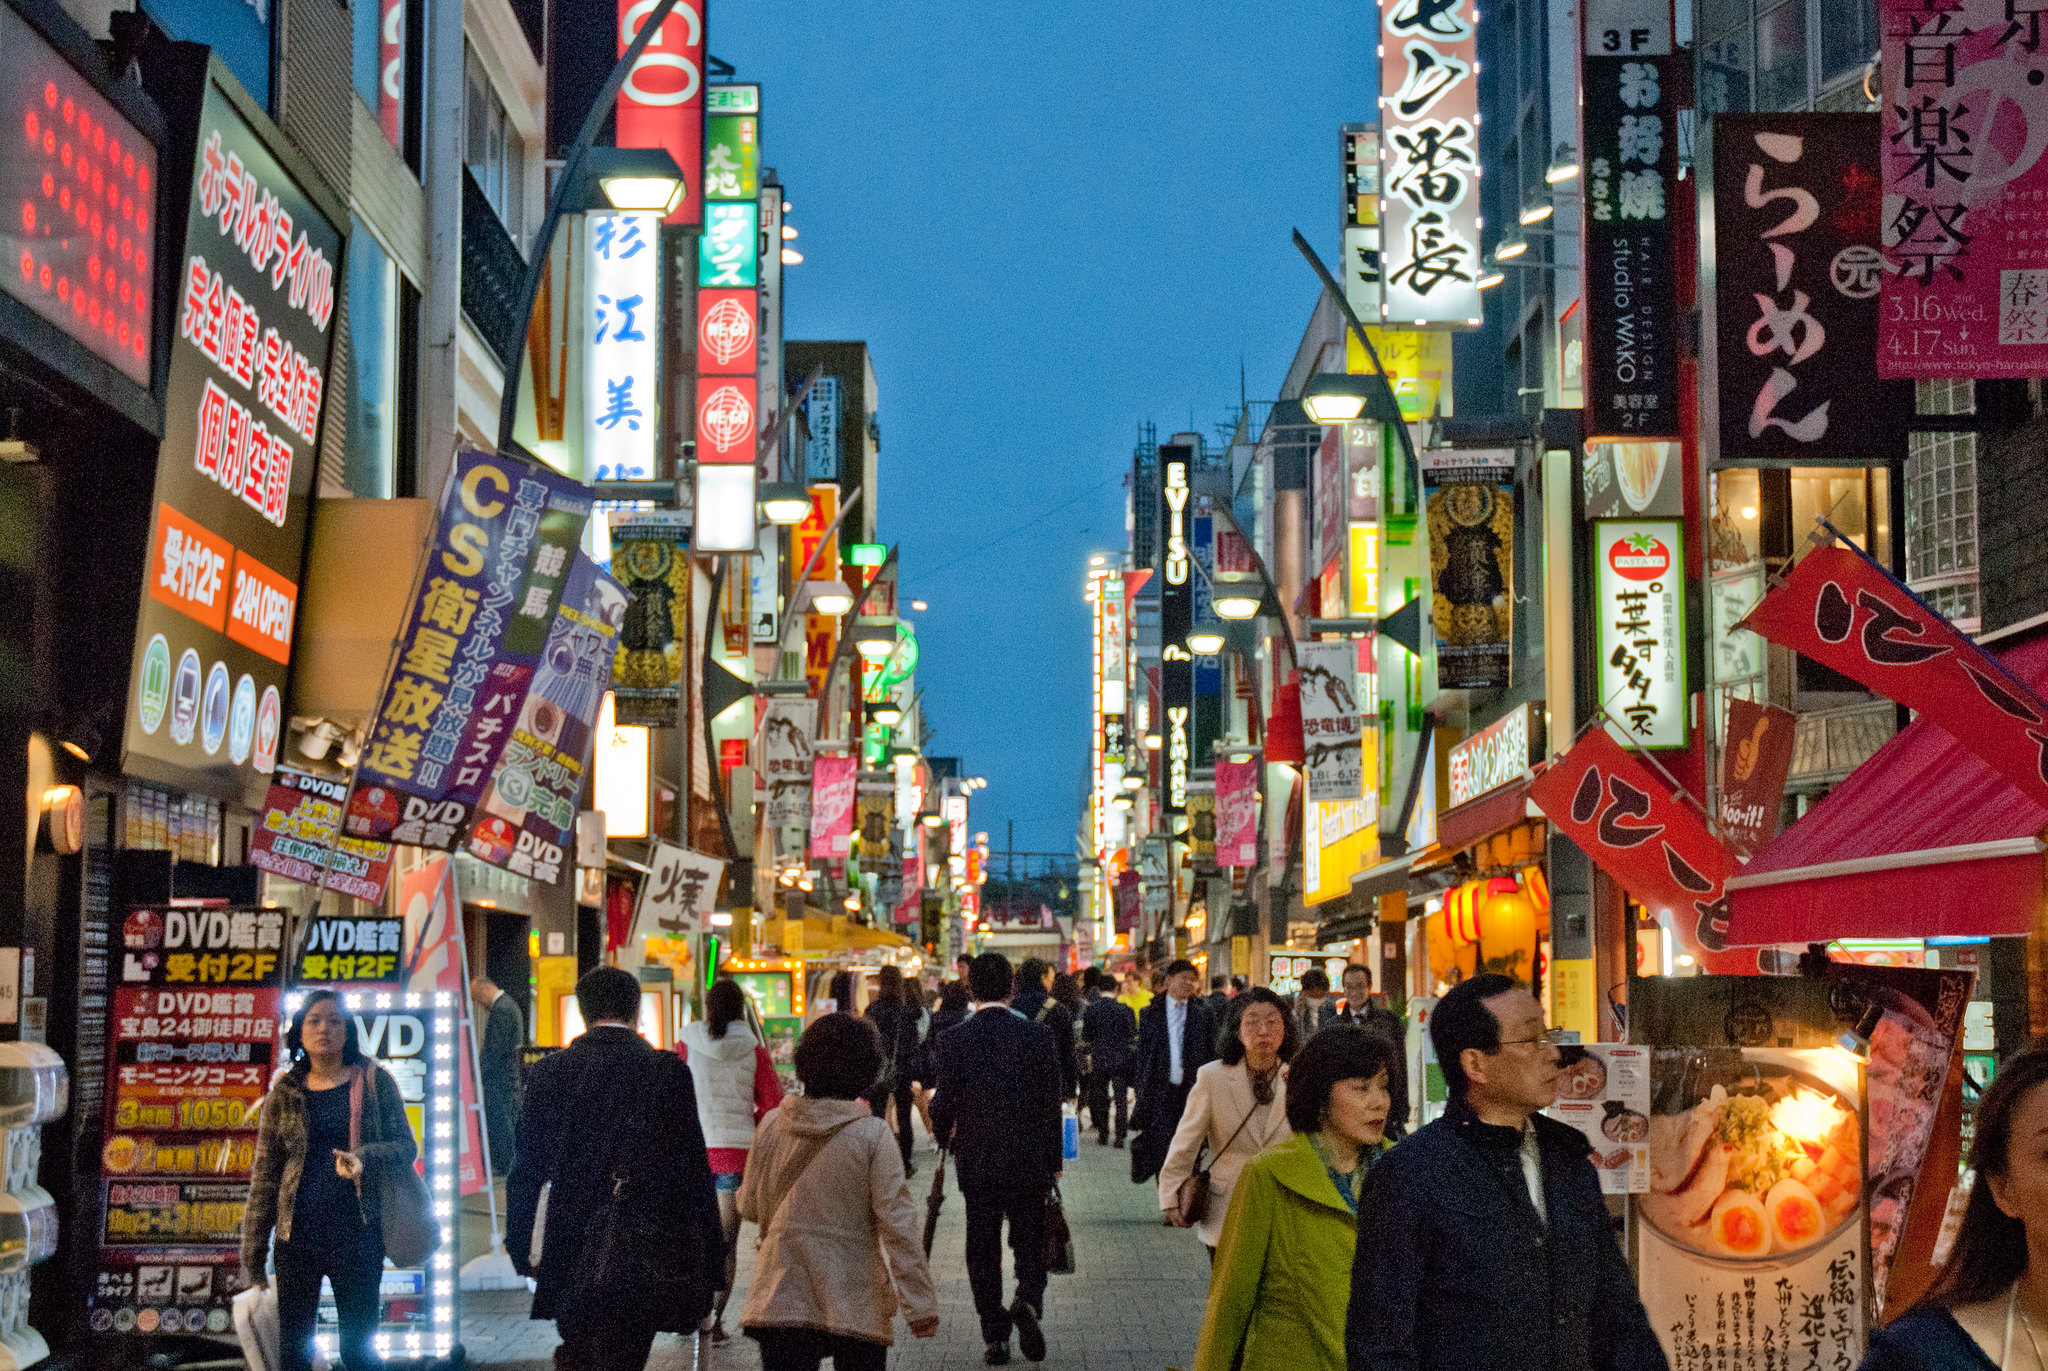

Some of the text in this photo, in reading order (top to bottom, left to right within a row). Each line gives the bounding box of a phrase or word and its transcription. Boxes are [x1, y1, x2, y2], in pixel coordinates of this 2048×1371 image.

[1603, 28, 1650, 51] 3F
[1744, 131, 1830, 443] らーめん
[1889, 295, 1942, 322] 3.16
[1616, 313, 1636, 383] WAKO
[1887, 329, 1942, 355] 4.17
[194, 376, 294, 528] 個別空調
[1165, 461, 1190, 585] EVISU
[160, 525, 225, 608] 受付2F
[519, 542, 568, 619] 競馬
[259, 584, 295, 645] OPEN
[455, 691, 518, 787] パチスロ
[1167, 706, 1189, 808] YAMANE
[403, 796, 466, 824] DVD
[391, 819, 457, 847] 鑑賞
[517, 830, 563, 865] DVD
[507, 849, 560, 885] 鑑賞
[164, 911, 284, 950] DVD鑑賞
[165, 953, 278, 983] 受付2F
[301, 954, 397, 979] 受付2F
[157, 993, 255, 1015] DVD鑑賞
[119, 1017, 275, 1039] 宝島24御徒町店
[355, 1013, 426, 1058] VD
[120, 1067, 261, 1085] モーニングコース
